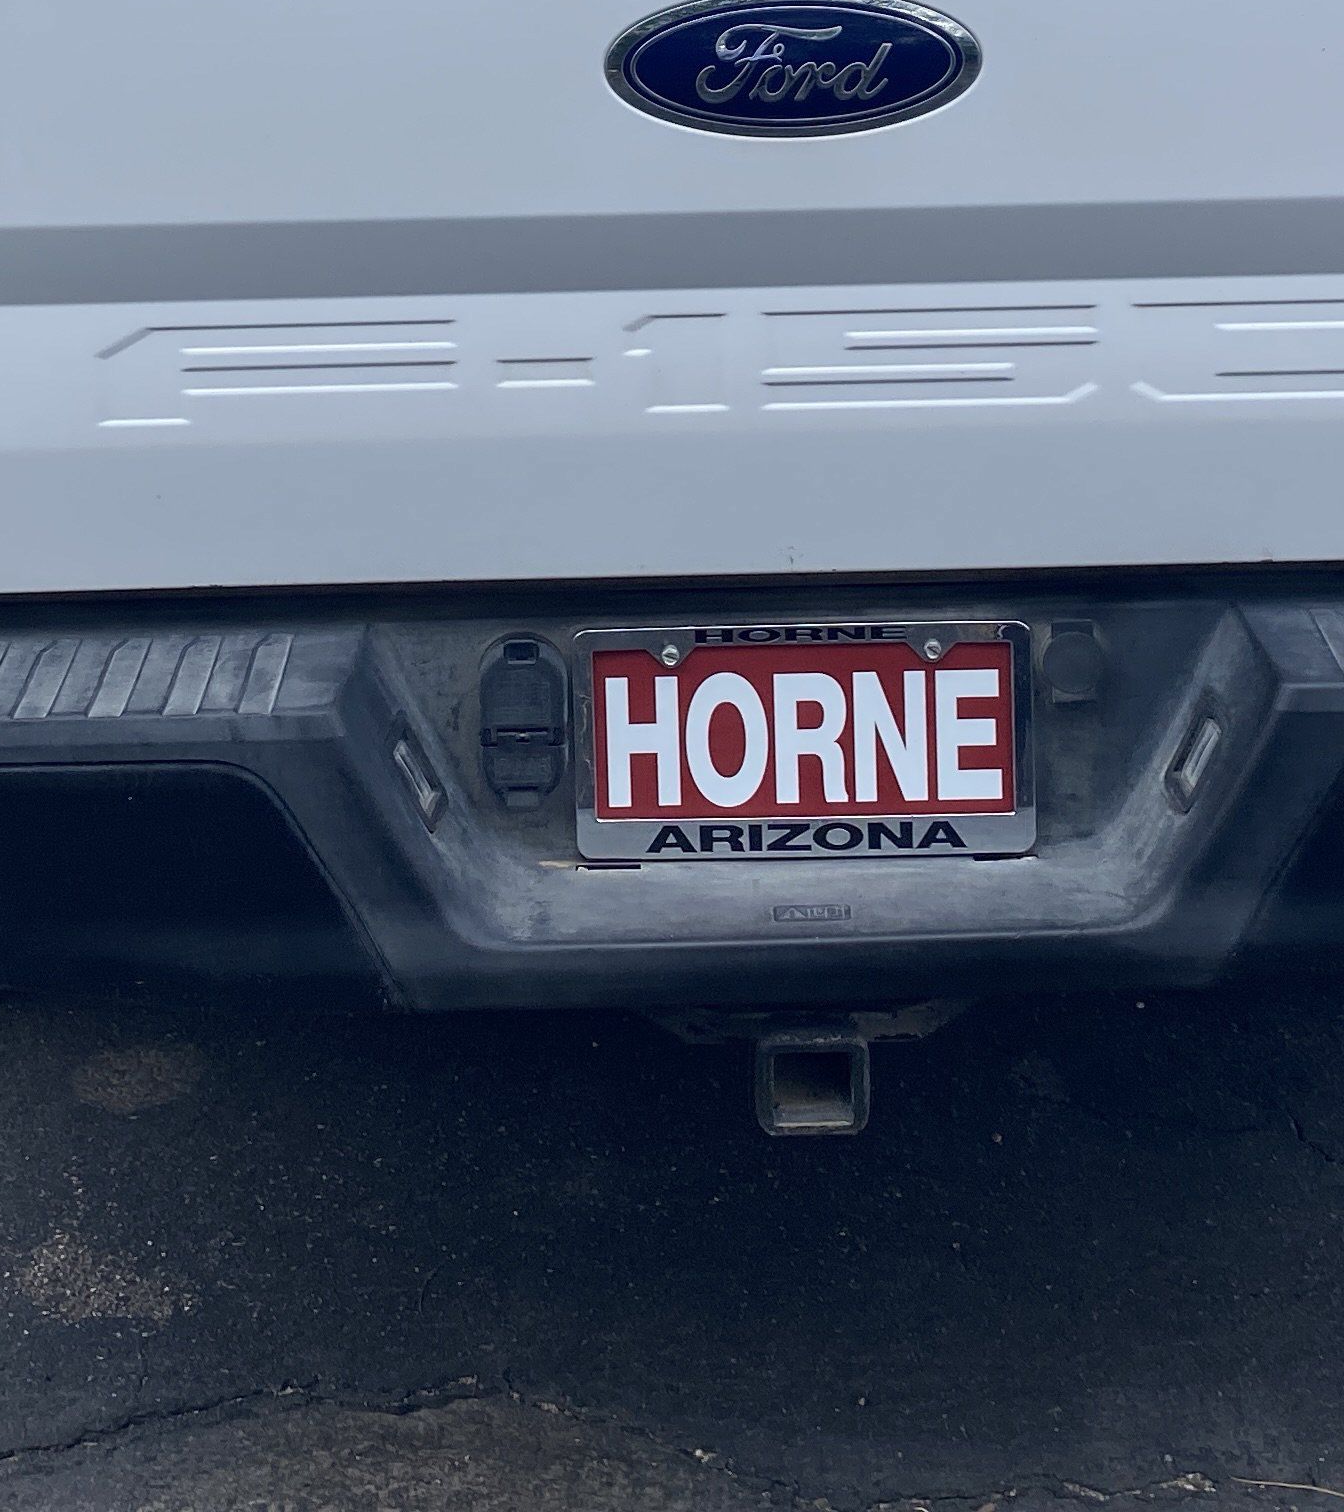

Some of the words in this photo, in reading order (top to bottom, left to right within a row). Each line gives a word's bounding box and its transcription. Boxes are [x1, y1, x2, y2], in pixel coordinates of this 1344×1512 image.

[696, 22, 892, 104] Ford
[695, 625, 906, 644] HORNE
[604, 668, 1003, 809] HORNE
[646, 821, 967, 853] ARIZONA
